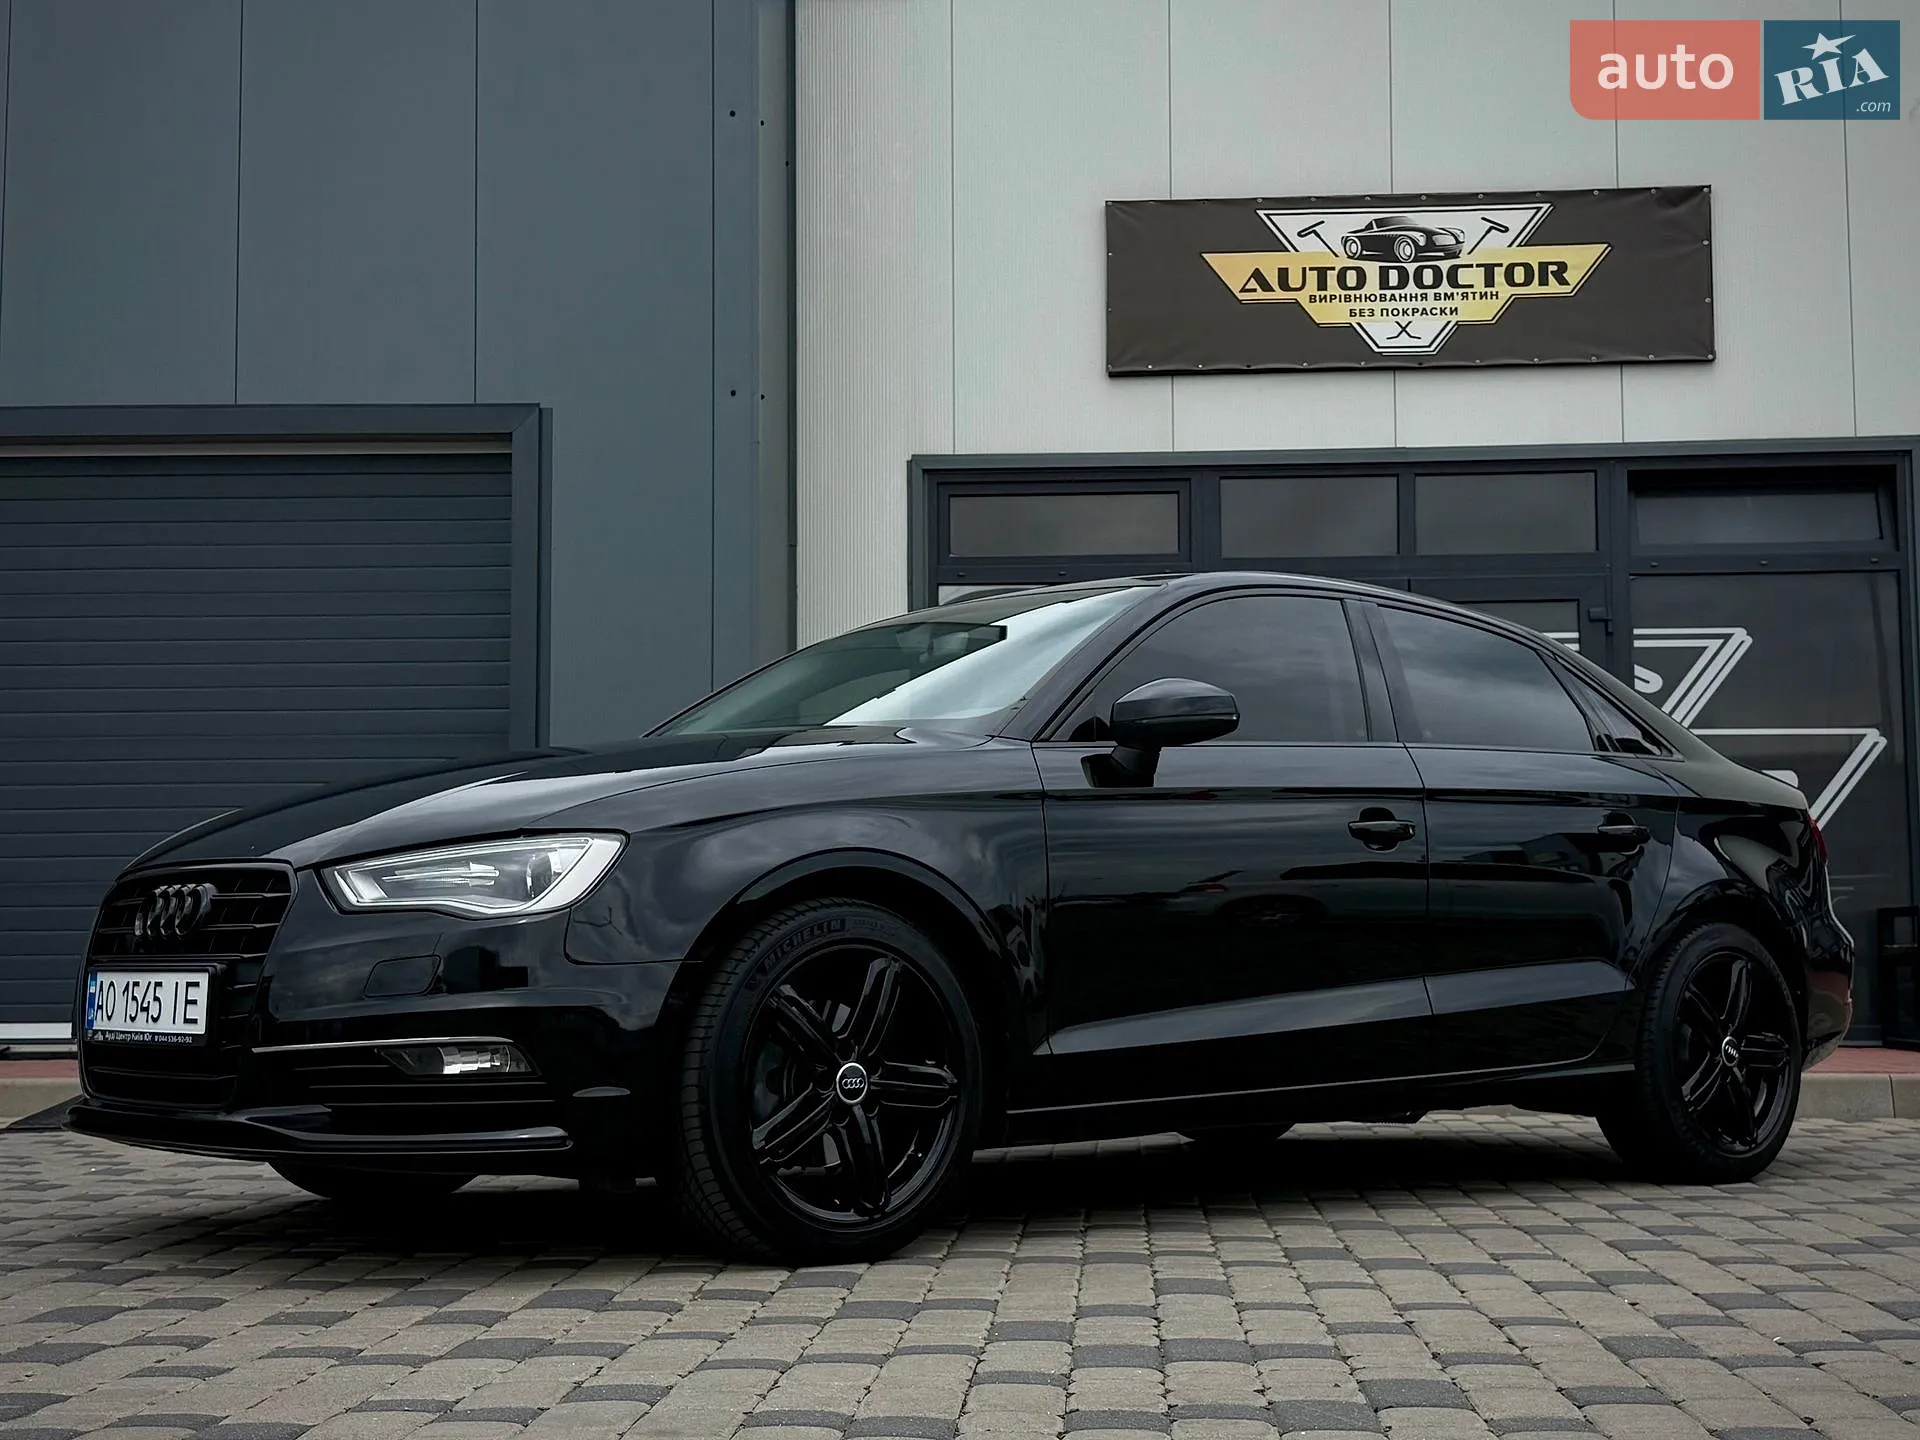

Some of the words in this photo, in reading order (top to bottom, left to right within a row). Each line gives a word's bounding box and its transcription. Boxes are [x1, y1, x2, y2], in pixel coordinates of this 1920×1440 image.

[1239, 265, 1367, 293] AUTO
[1378, 261, 1571, 291] DOCTOR
[1308, 293, 1428, 304] ВИРІВНЮВАННЯ
[1433, 290, 1499, 302] ВМ'ЯТИН
[1349, 307, 1375, 318] БЕЗ
[1380, 306, 1459, 317] ПОКРАСКИ
[95, 980, 116, 1021] AO
[122, 980, 163, 1023] 1545
[172, 980, 200, 1024] IE
